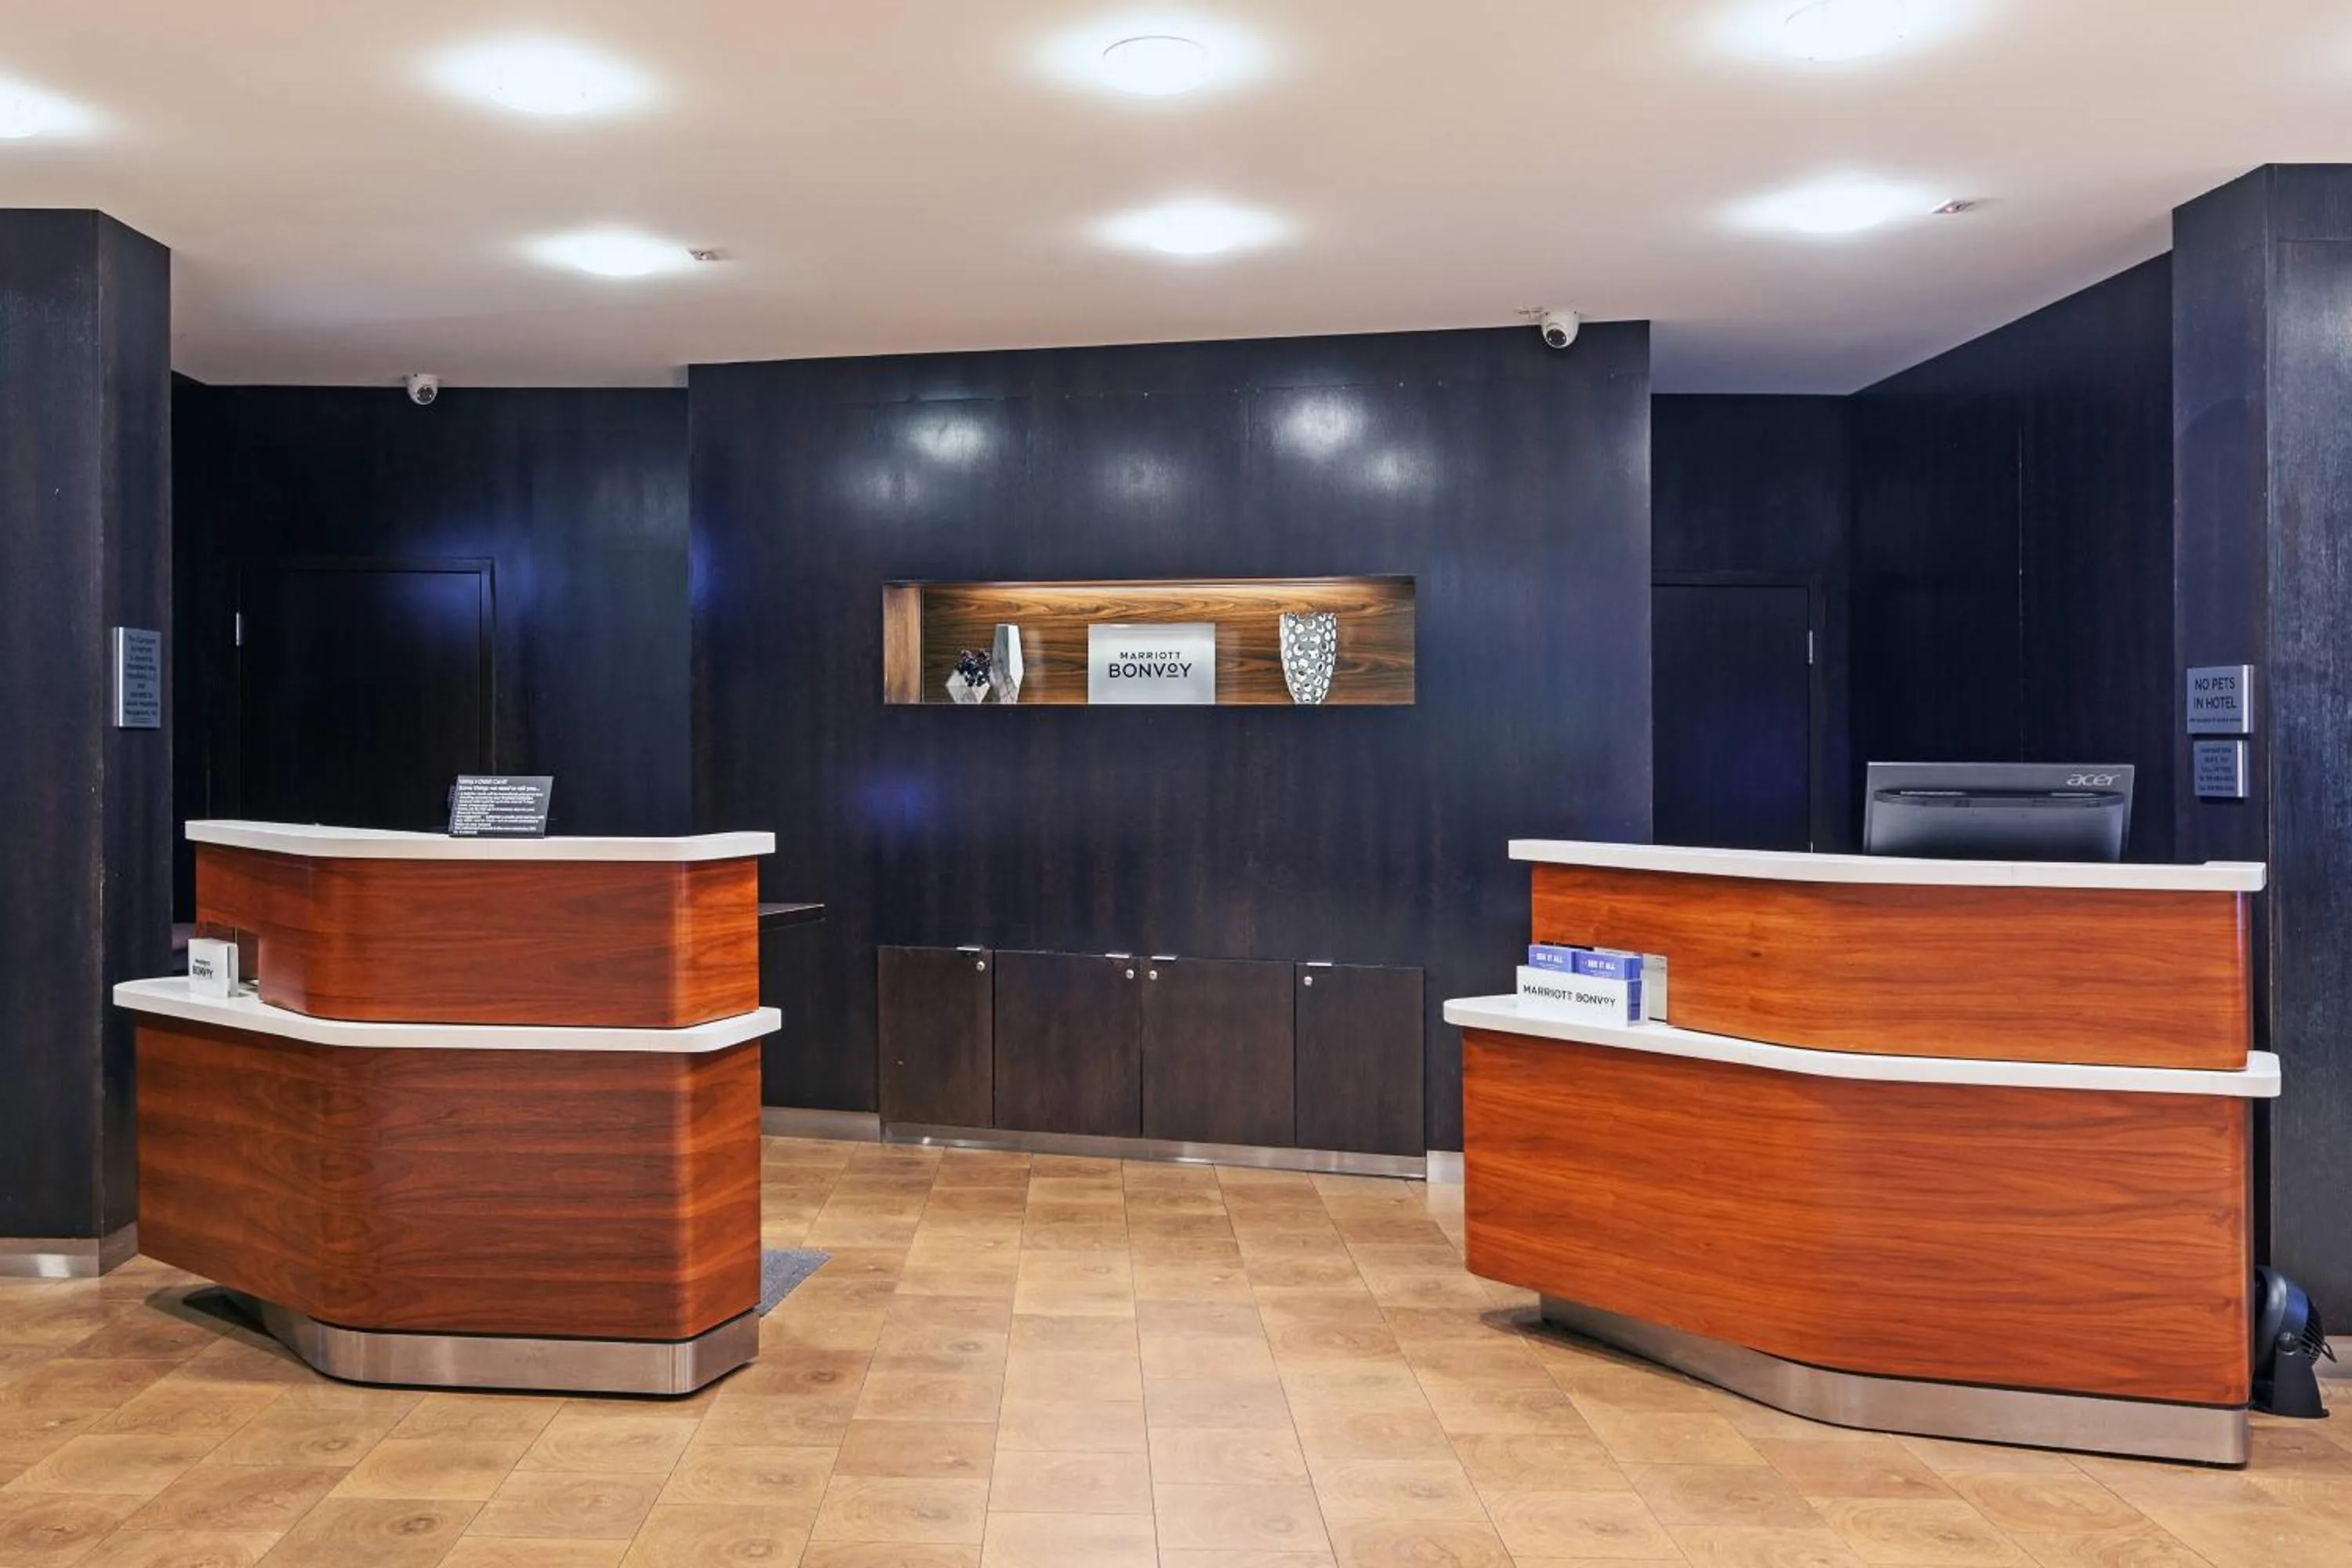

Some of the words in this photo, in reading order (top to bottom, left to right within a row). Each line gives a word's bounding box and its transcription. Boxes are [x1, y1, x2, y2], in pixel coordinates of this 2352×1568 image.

[1109, 662, 1192, 678] BONVOY
[2194, 677, 2210, 691] NO
[2212, 677, 2235, 691] PETS
[2193, 696, 2204, 710] IN
[2205, 695, 2237, 710] HOTEL
[2066, 773, 2121, 786] acer
[1523, 984, 1573, 1001] MARRIOTT
[1575, 993, 1616, 1007] BONVOY
